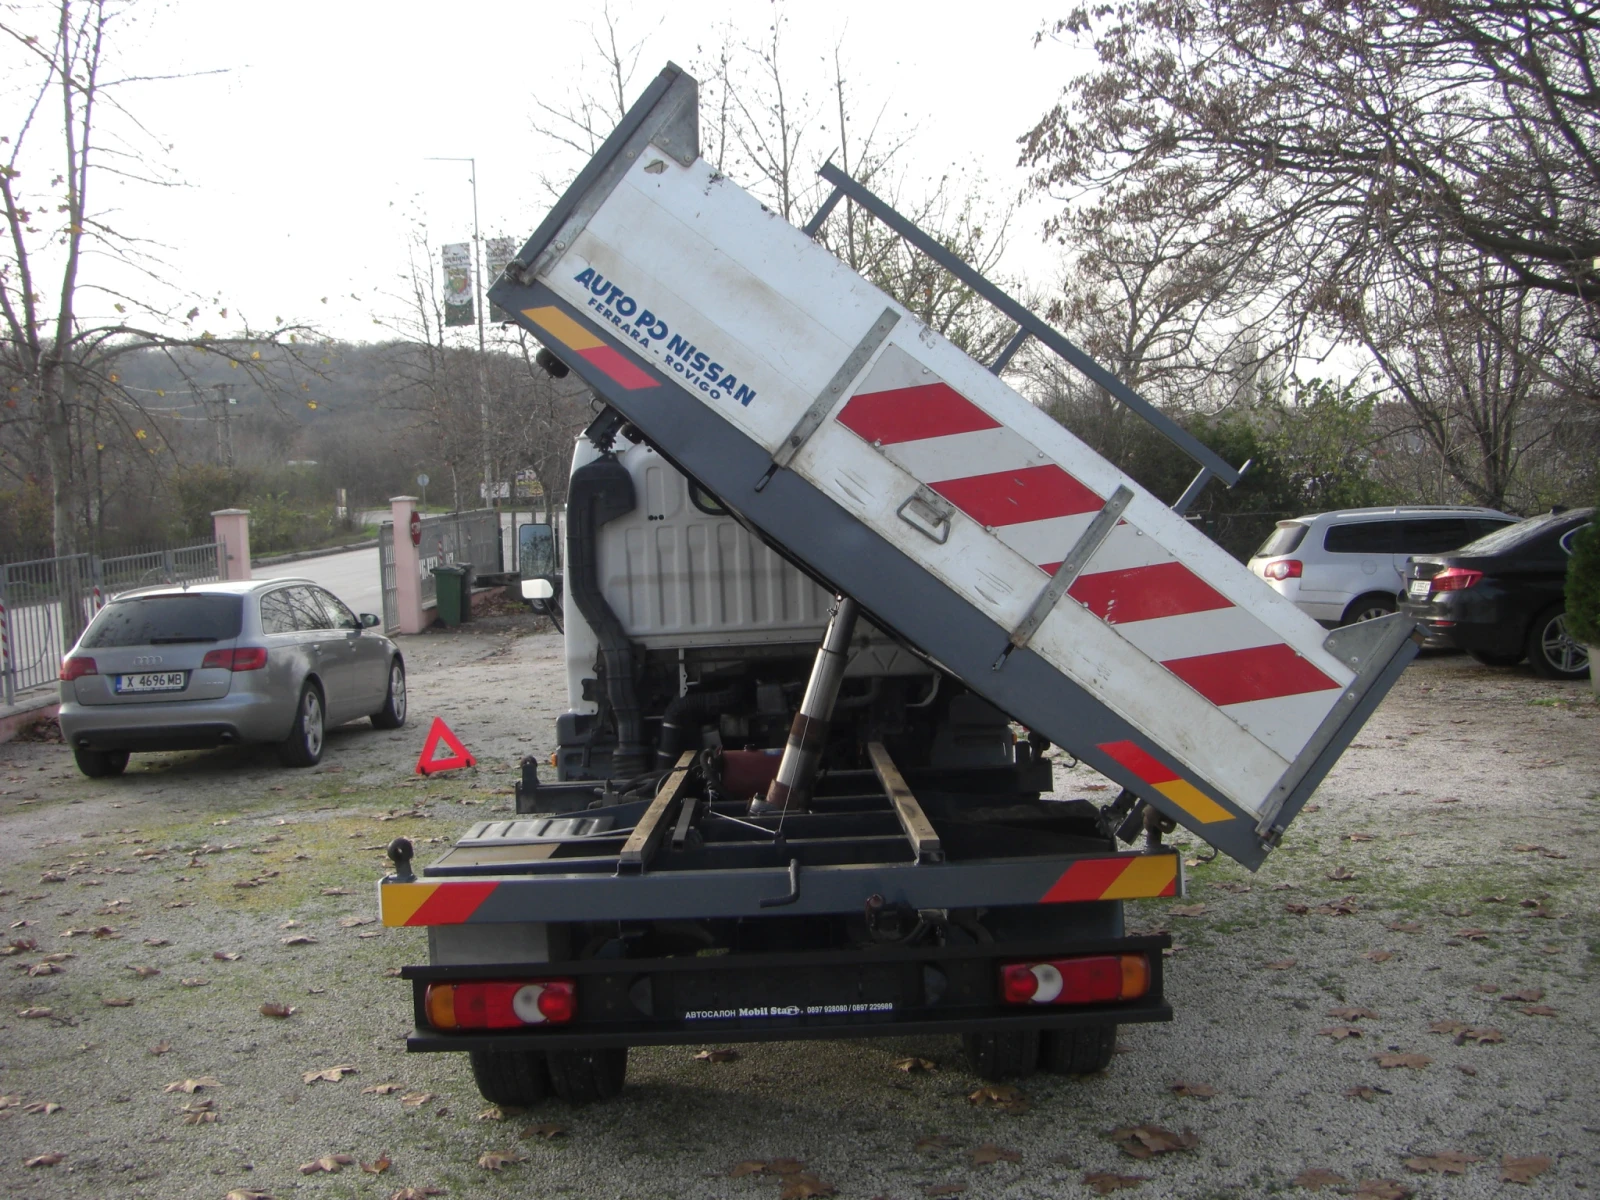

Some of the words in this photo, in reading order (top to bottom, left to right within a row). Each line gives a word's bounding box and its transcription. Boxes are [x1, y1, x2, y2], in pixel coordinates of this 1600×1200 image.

[574, 267, 637, 316] AUTO
[635, 309, 669, 341] PO
[666, 333, 757, 408] NISSAN
[587, 297, 650, 349] FERRARA
[664, 354, 721, 401] ROVIGO
[139, 674, 166, 687] 4696
[167, 673, 182, 685] MB
[685, 1010, 736, 1019] АВТОСАЛОН
[739, 1007, 768, 1017] Mobil
[807, 1006, 823, 1014] 0897
[852, 1003, 868, 1011] 0897
